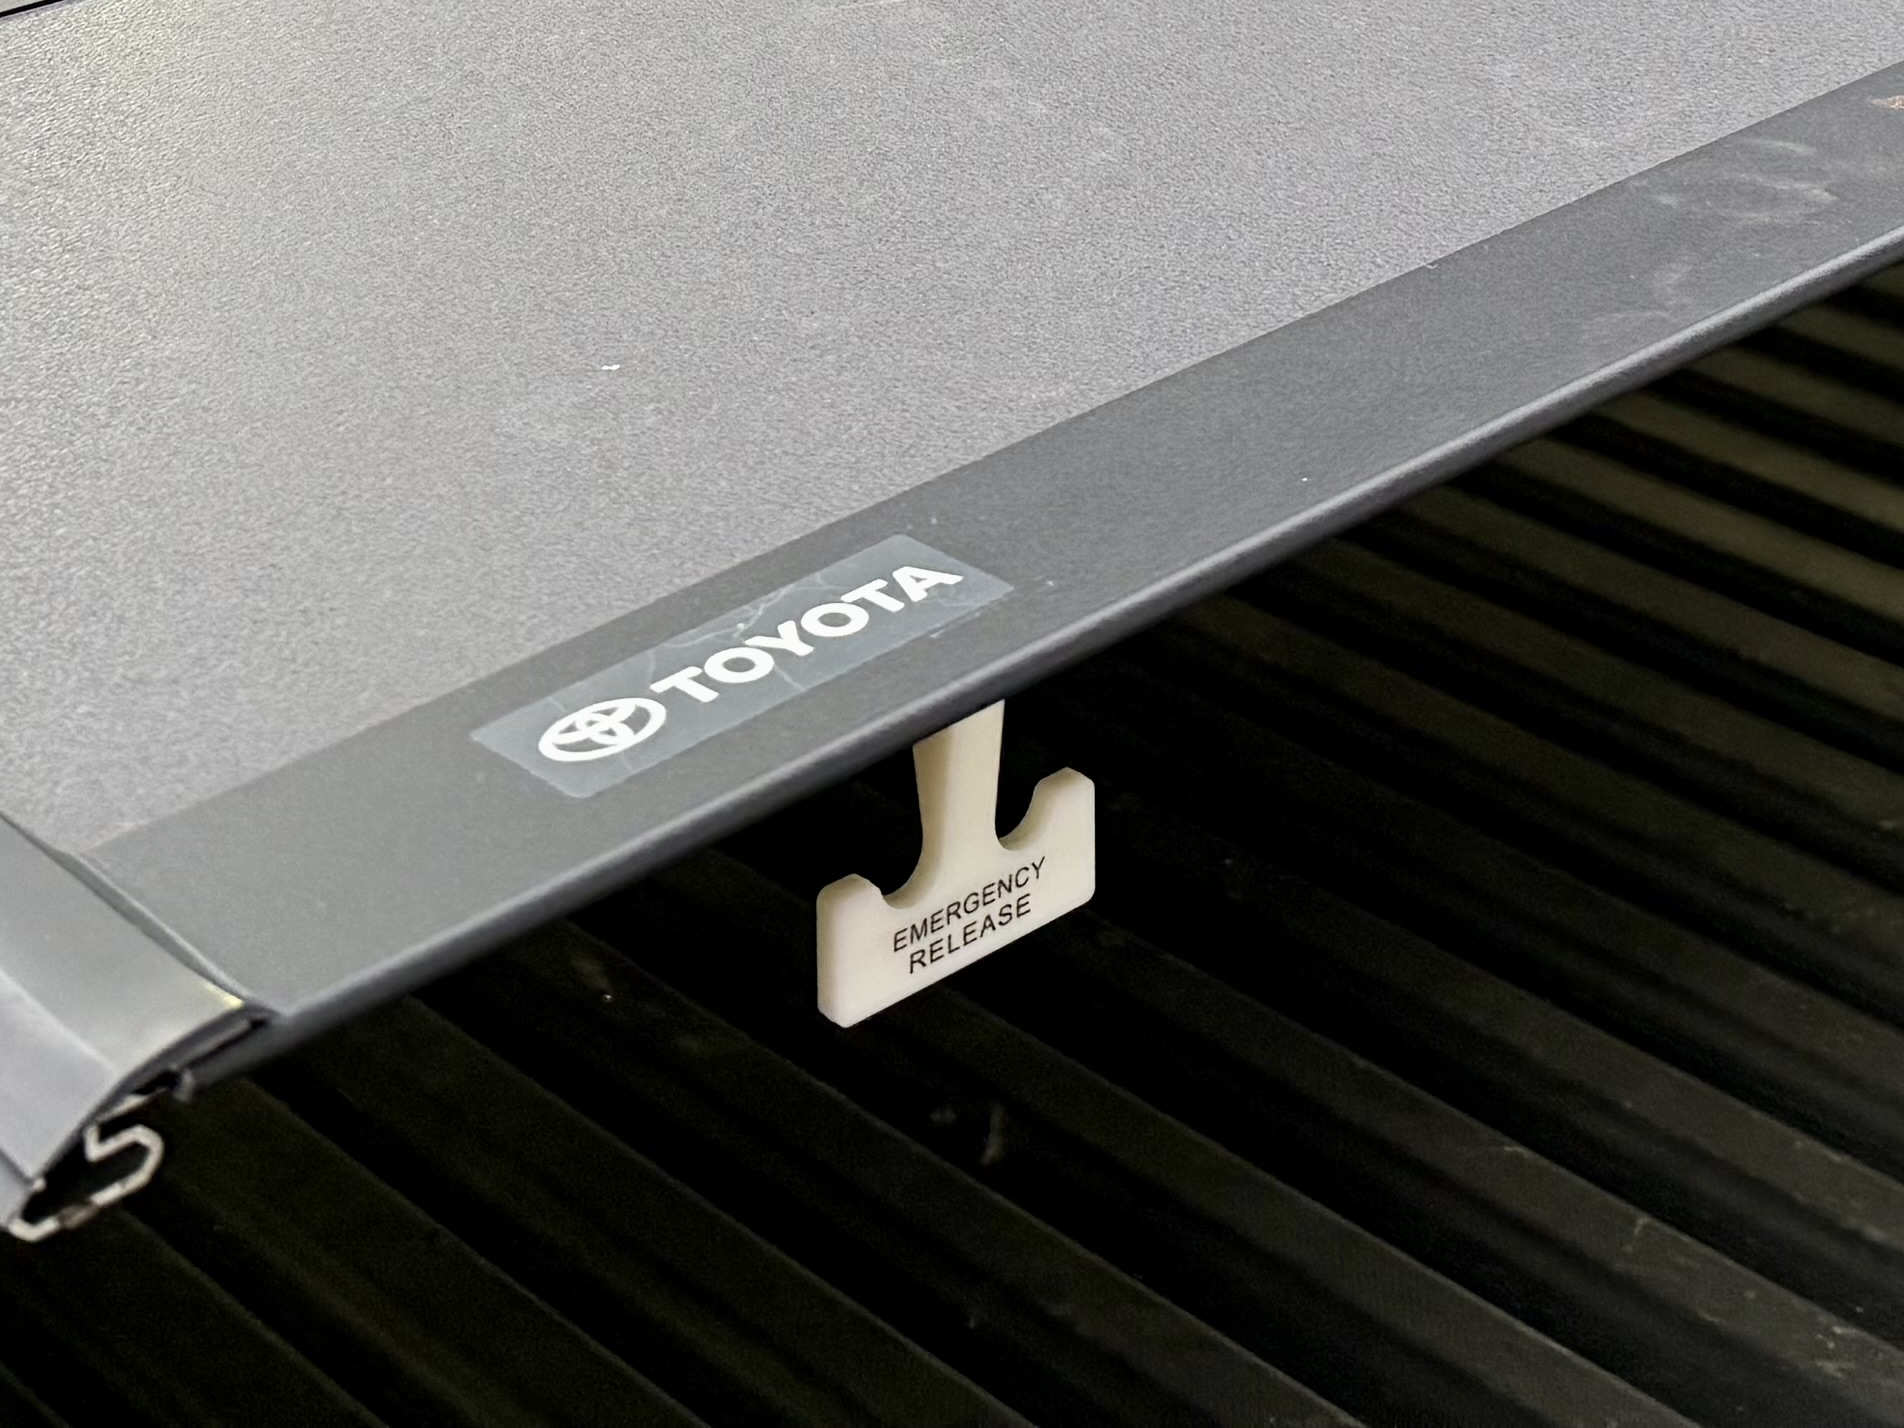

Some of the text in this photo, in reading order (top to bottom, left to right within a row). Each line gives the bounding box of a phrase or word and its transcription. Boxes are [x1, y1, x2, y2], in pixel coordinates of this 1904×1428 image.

[649, 563, 964, 703] TOYOTA
[892, 855, 1047, 954] EMERGENCY
[908, 899, 1032, 974] RELEASE
